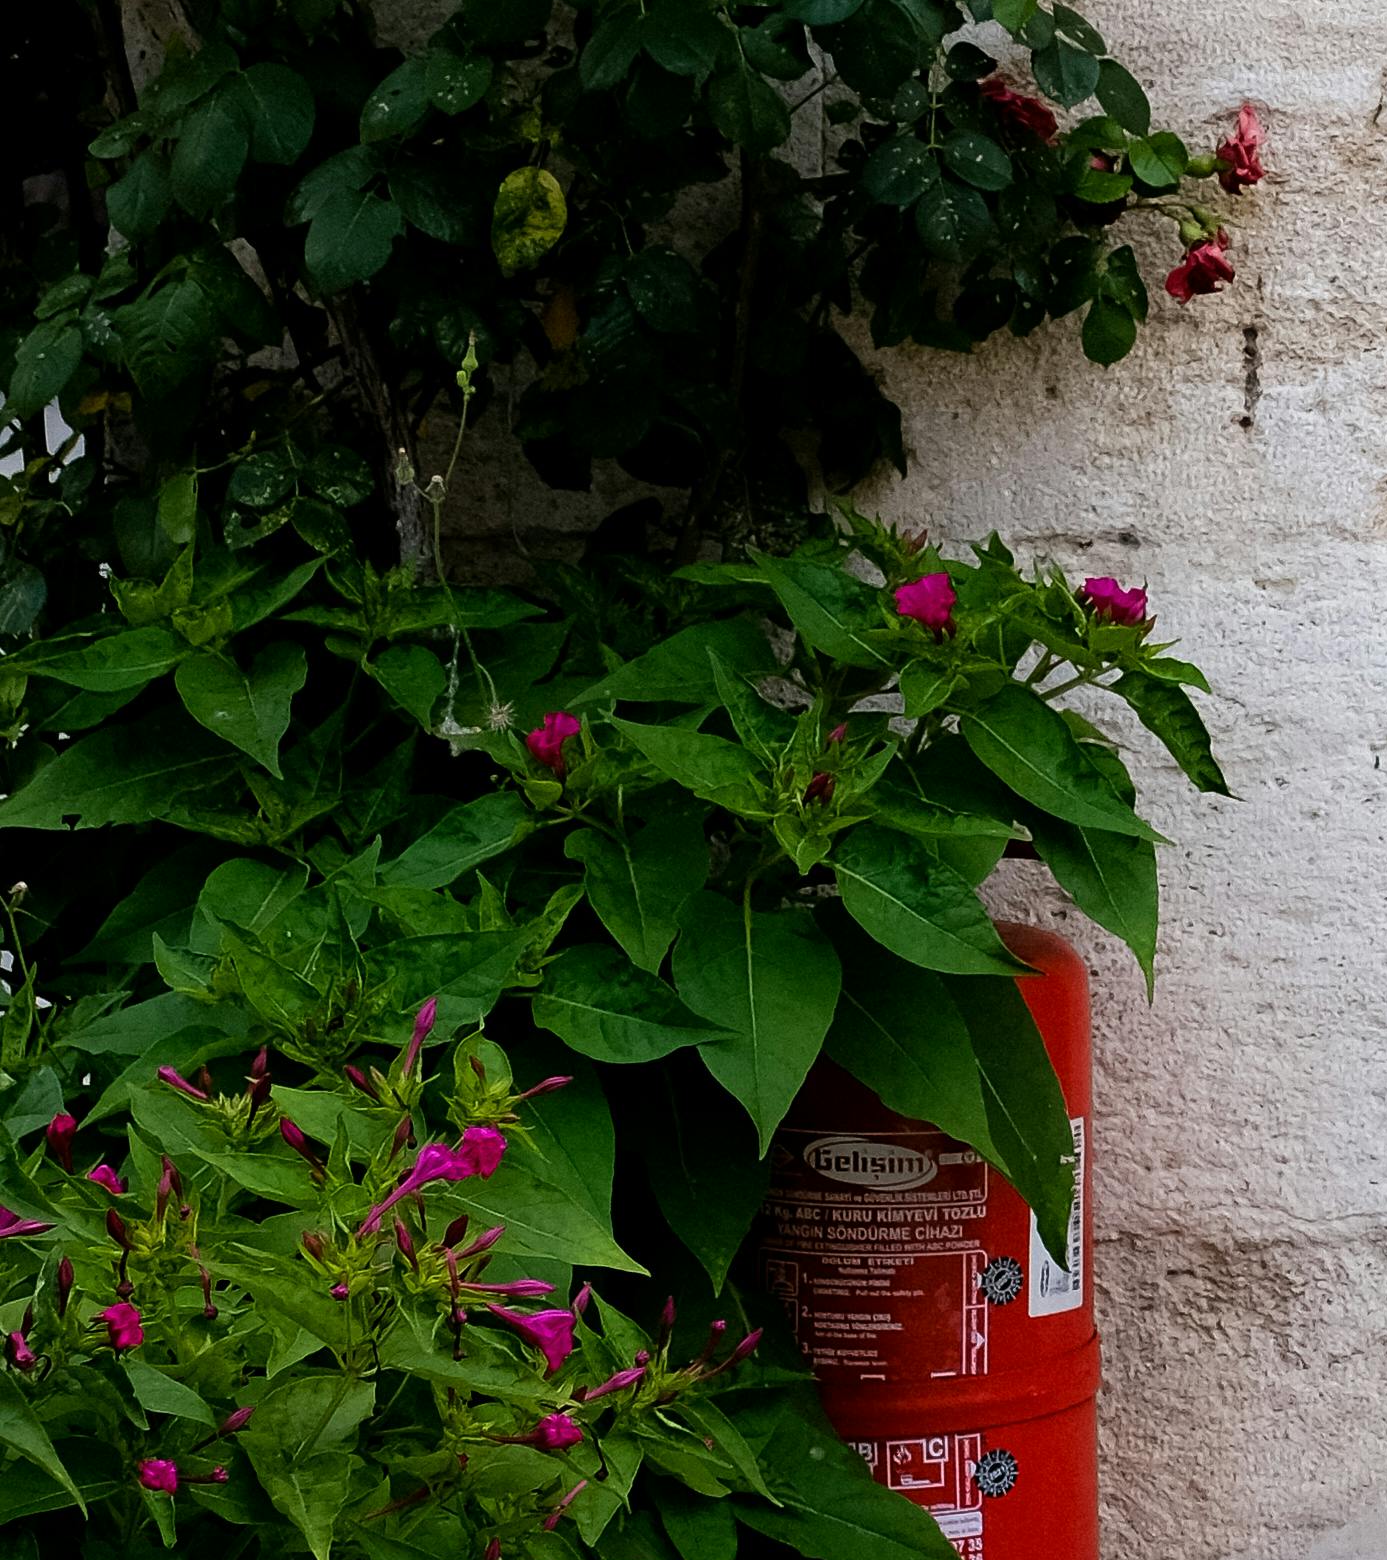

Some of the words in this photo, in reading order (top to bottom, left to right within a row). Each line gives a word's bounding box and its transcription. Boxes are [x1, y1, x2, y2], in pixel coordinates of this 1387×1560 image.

[815, 1148, 925, 1181] Gelişim
[795, 1206, 822, 1221] ABC
[832, 1209, 873, 1223] KURU
[877, 1206, 938, 1223] KİMYEVİ
[942, 1204, 987, 1221] TOZLU
[826, 1224, 912, 1241] SÖNDÜRME
[915, 1223, 964, 1240] CİHAZI
[929, 1438, 944, 1458] C
